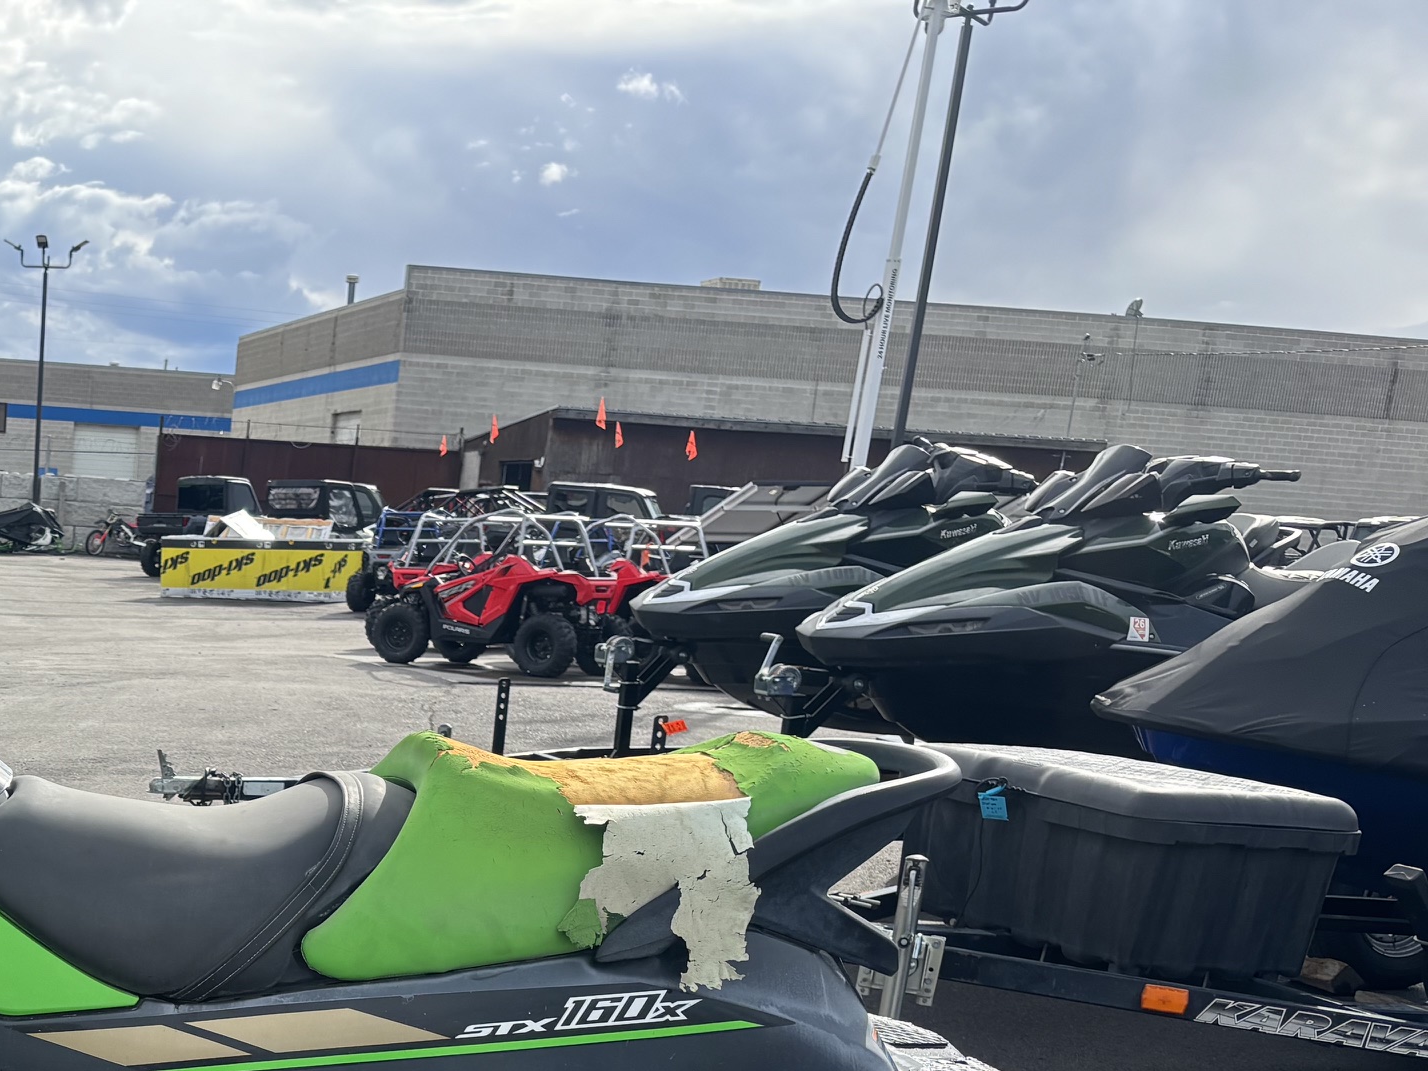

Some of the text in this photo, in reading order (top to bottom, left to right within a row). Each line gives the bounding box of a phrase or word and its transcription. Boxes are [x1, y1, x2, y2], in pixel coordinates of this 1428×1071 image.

[190, 551, 257, 586] ski-doo
[255, 553, 325, 588] ski-doo
[442, 623, 470, 635] POLARIS
[1134, 618, 1146, 629] 26
[455, 1017, 558, 1039] STX
